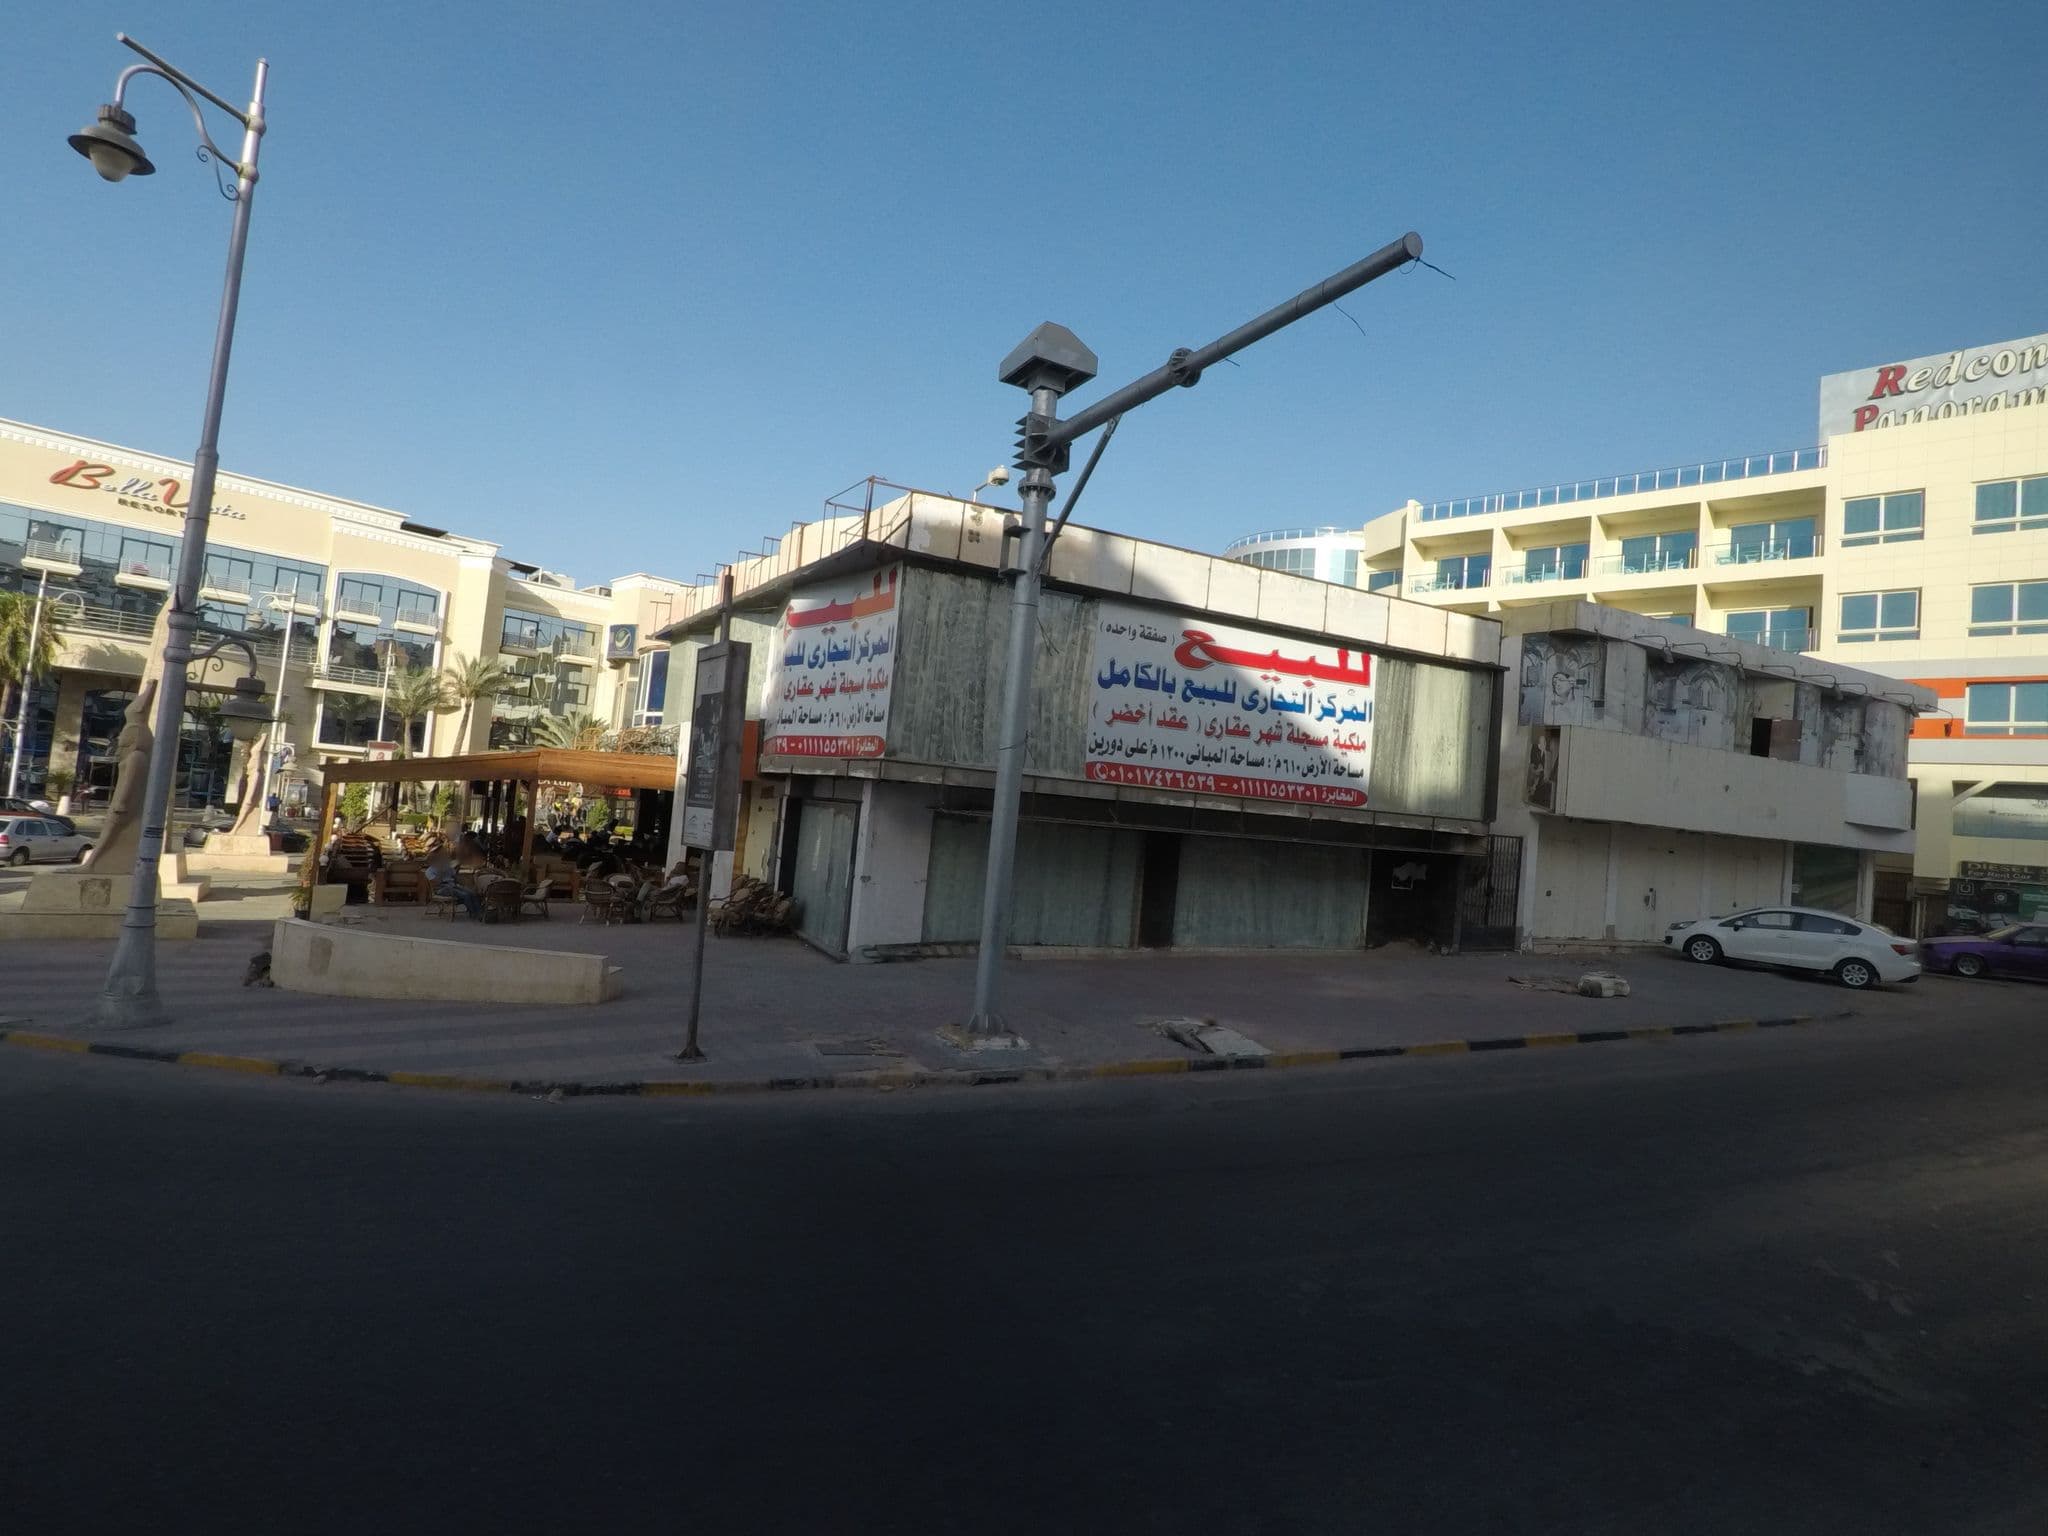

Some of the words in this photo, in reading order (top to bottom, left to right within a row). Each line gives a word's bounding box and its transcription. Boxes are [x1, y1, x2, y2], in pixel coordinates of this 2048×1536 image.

[1866, 344, 2048, 401] Redcon
[50, 460, 158, 502] Bella
[158, 478, 247, 521] Vsta
[117, 497, 187, 519] RESORT
[1174, 629, 1372, 687] للبيع
[1097, 656, 1176, 700] بالكامل
[1181, 676, 1237, 707] للبيع
[1315, 692, 1373, 724] المركز
[1088, 731, 1123, 757] دورين
[1254, 719, 1283, 747] شهر
[1286, 721, 1329, 752] مسجلة
[1333, 727, 1367, 758] ملكية
[1229, 745, 1266, 768] مساحة
[1300, 754, 1332, 778] الأرض
[1332, 758, 1365, 779] مساحة
